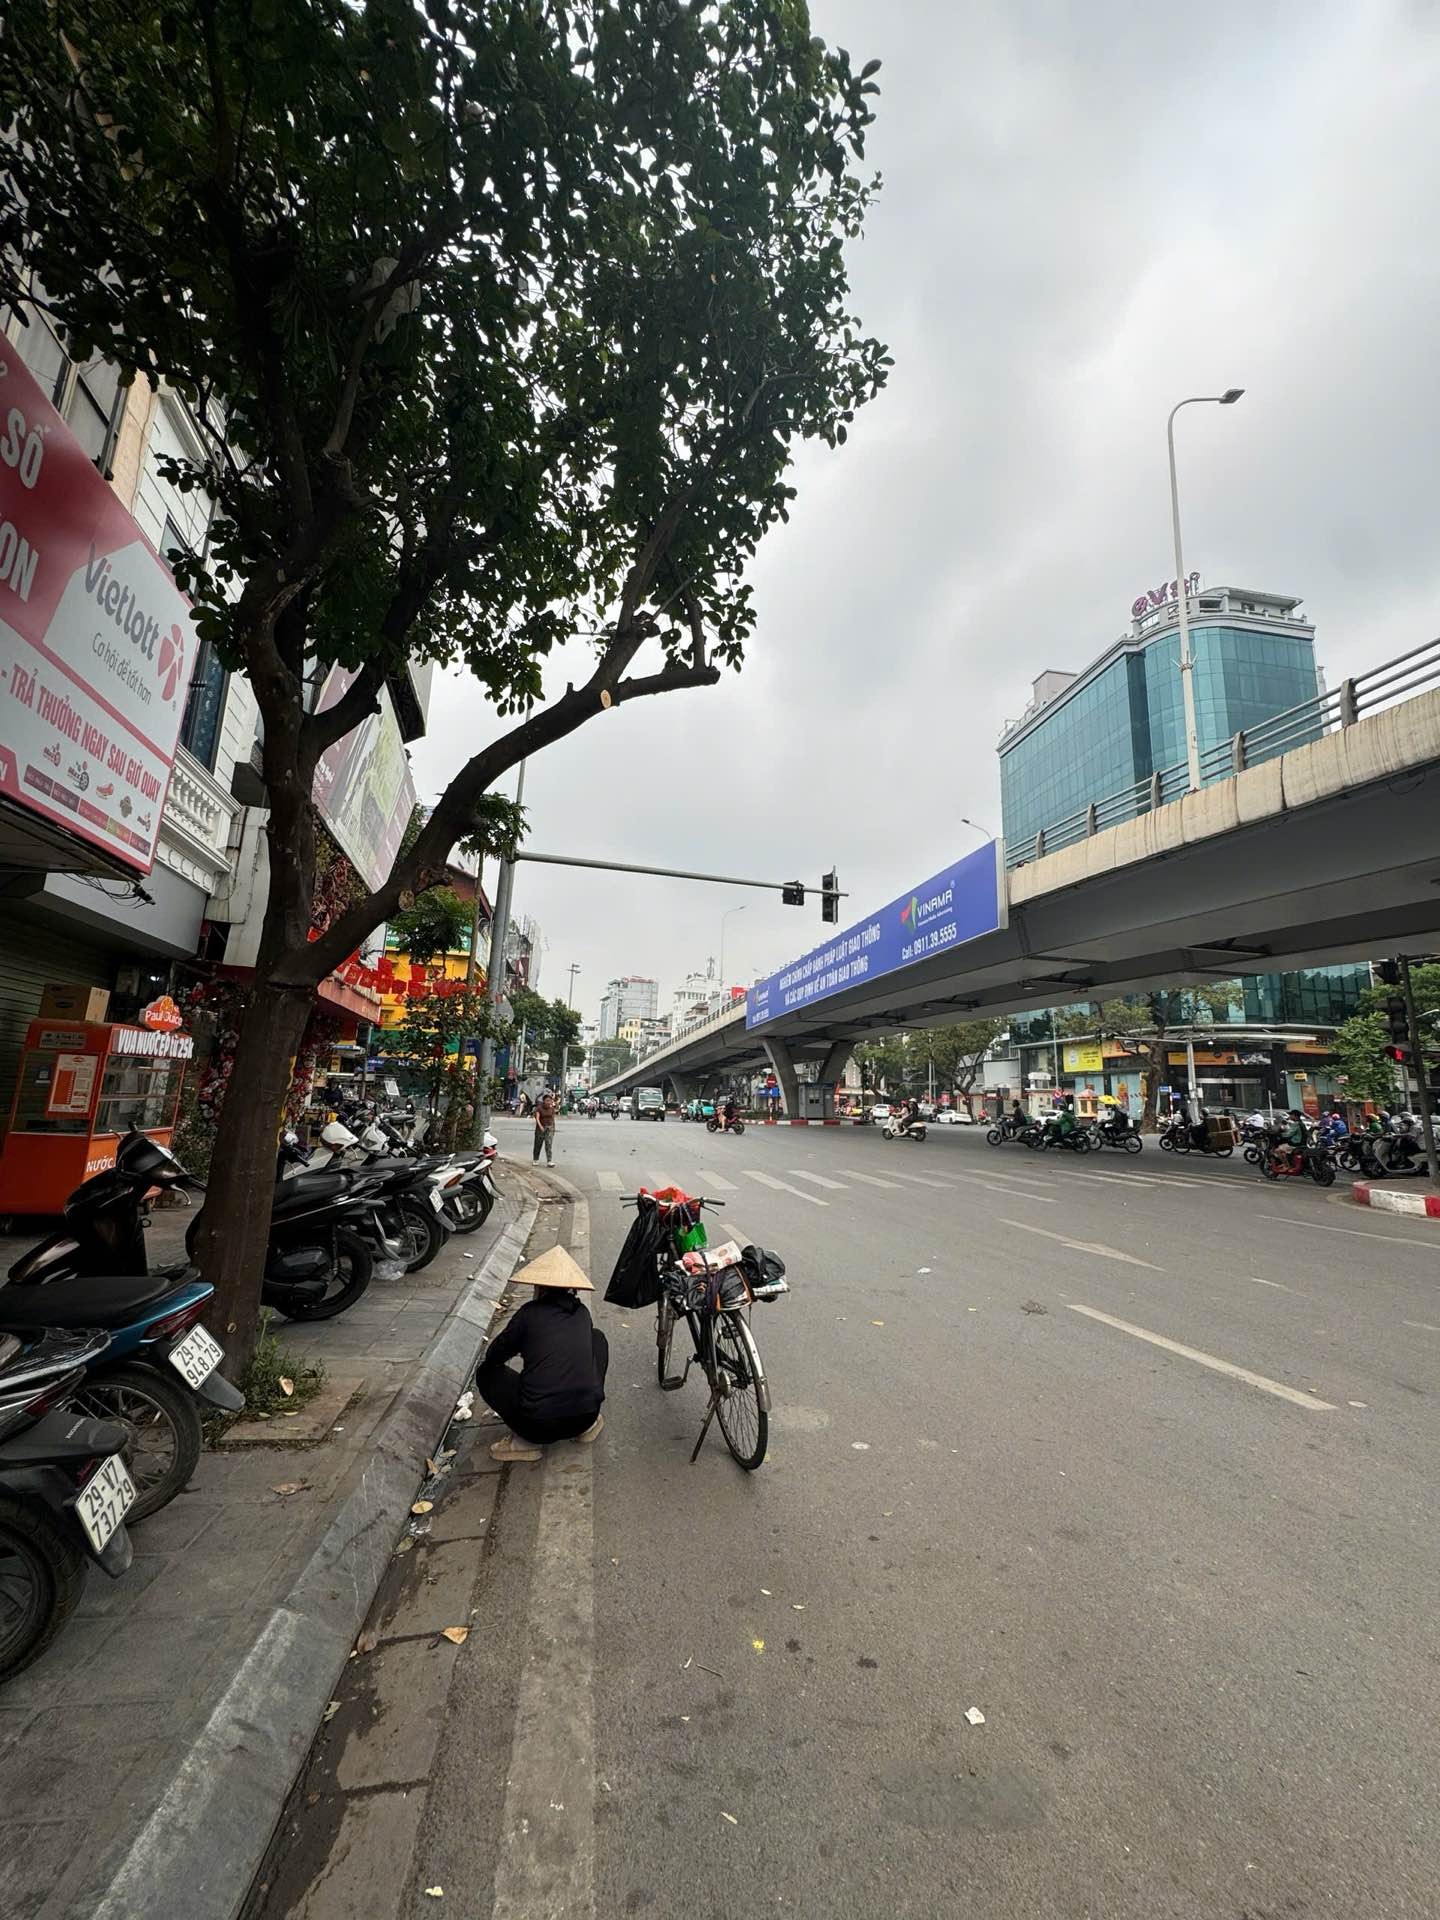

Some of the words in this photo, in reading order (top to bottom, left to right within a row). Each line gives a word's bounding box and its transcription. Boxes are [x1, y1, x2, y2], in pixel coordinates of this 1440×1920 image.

[0, 521, 39, 603] ON
[85, 542, 160, 661] Vietlott
[10, 663, 38, 709] TRẢ
[36, 685, 82, 743] THƯỞNG
[80, 722, 110, 762] NGAY
[107, 743, 128, 777] SAU
[125, 758, 144, 789] GIỜ
[141, 770, 162, 804] QUAY
[917, 889, 953, 918] VINAMA
[913, 922, 957, 955] 0911.39.5555
[145, 1010, 163, 1022] Paul
[163, 1011, 183, 1026] Juice
[117, 1028, 137, 1054] VUA
[136, 1030, 160, 1056] NƯỚC
[176, 1331, 207, 1367] 29-X1
[186, 1343, 221, 1385] 948.79
[84, 1460, 119, 1519] 29-V7
[91, 1477, 134, 1548] 737.29
